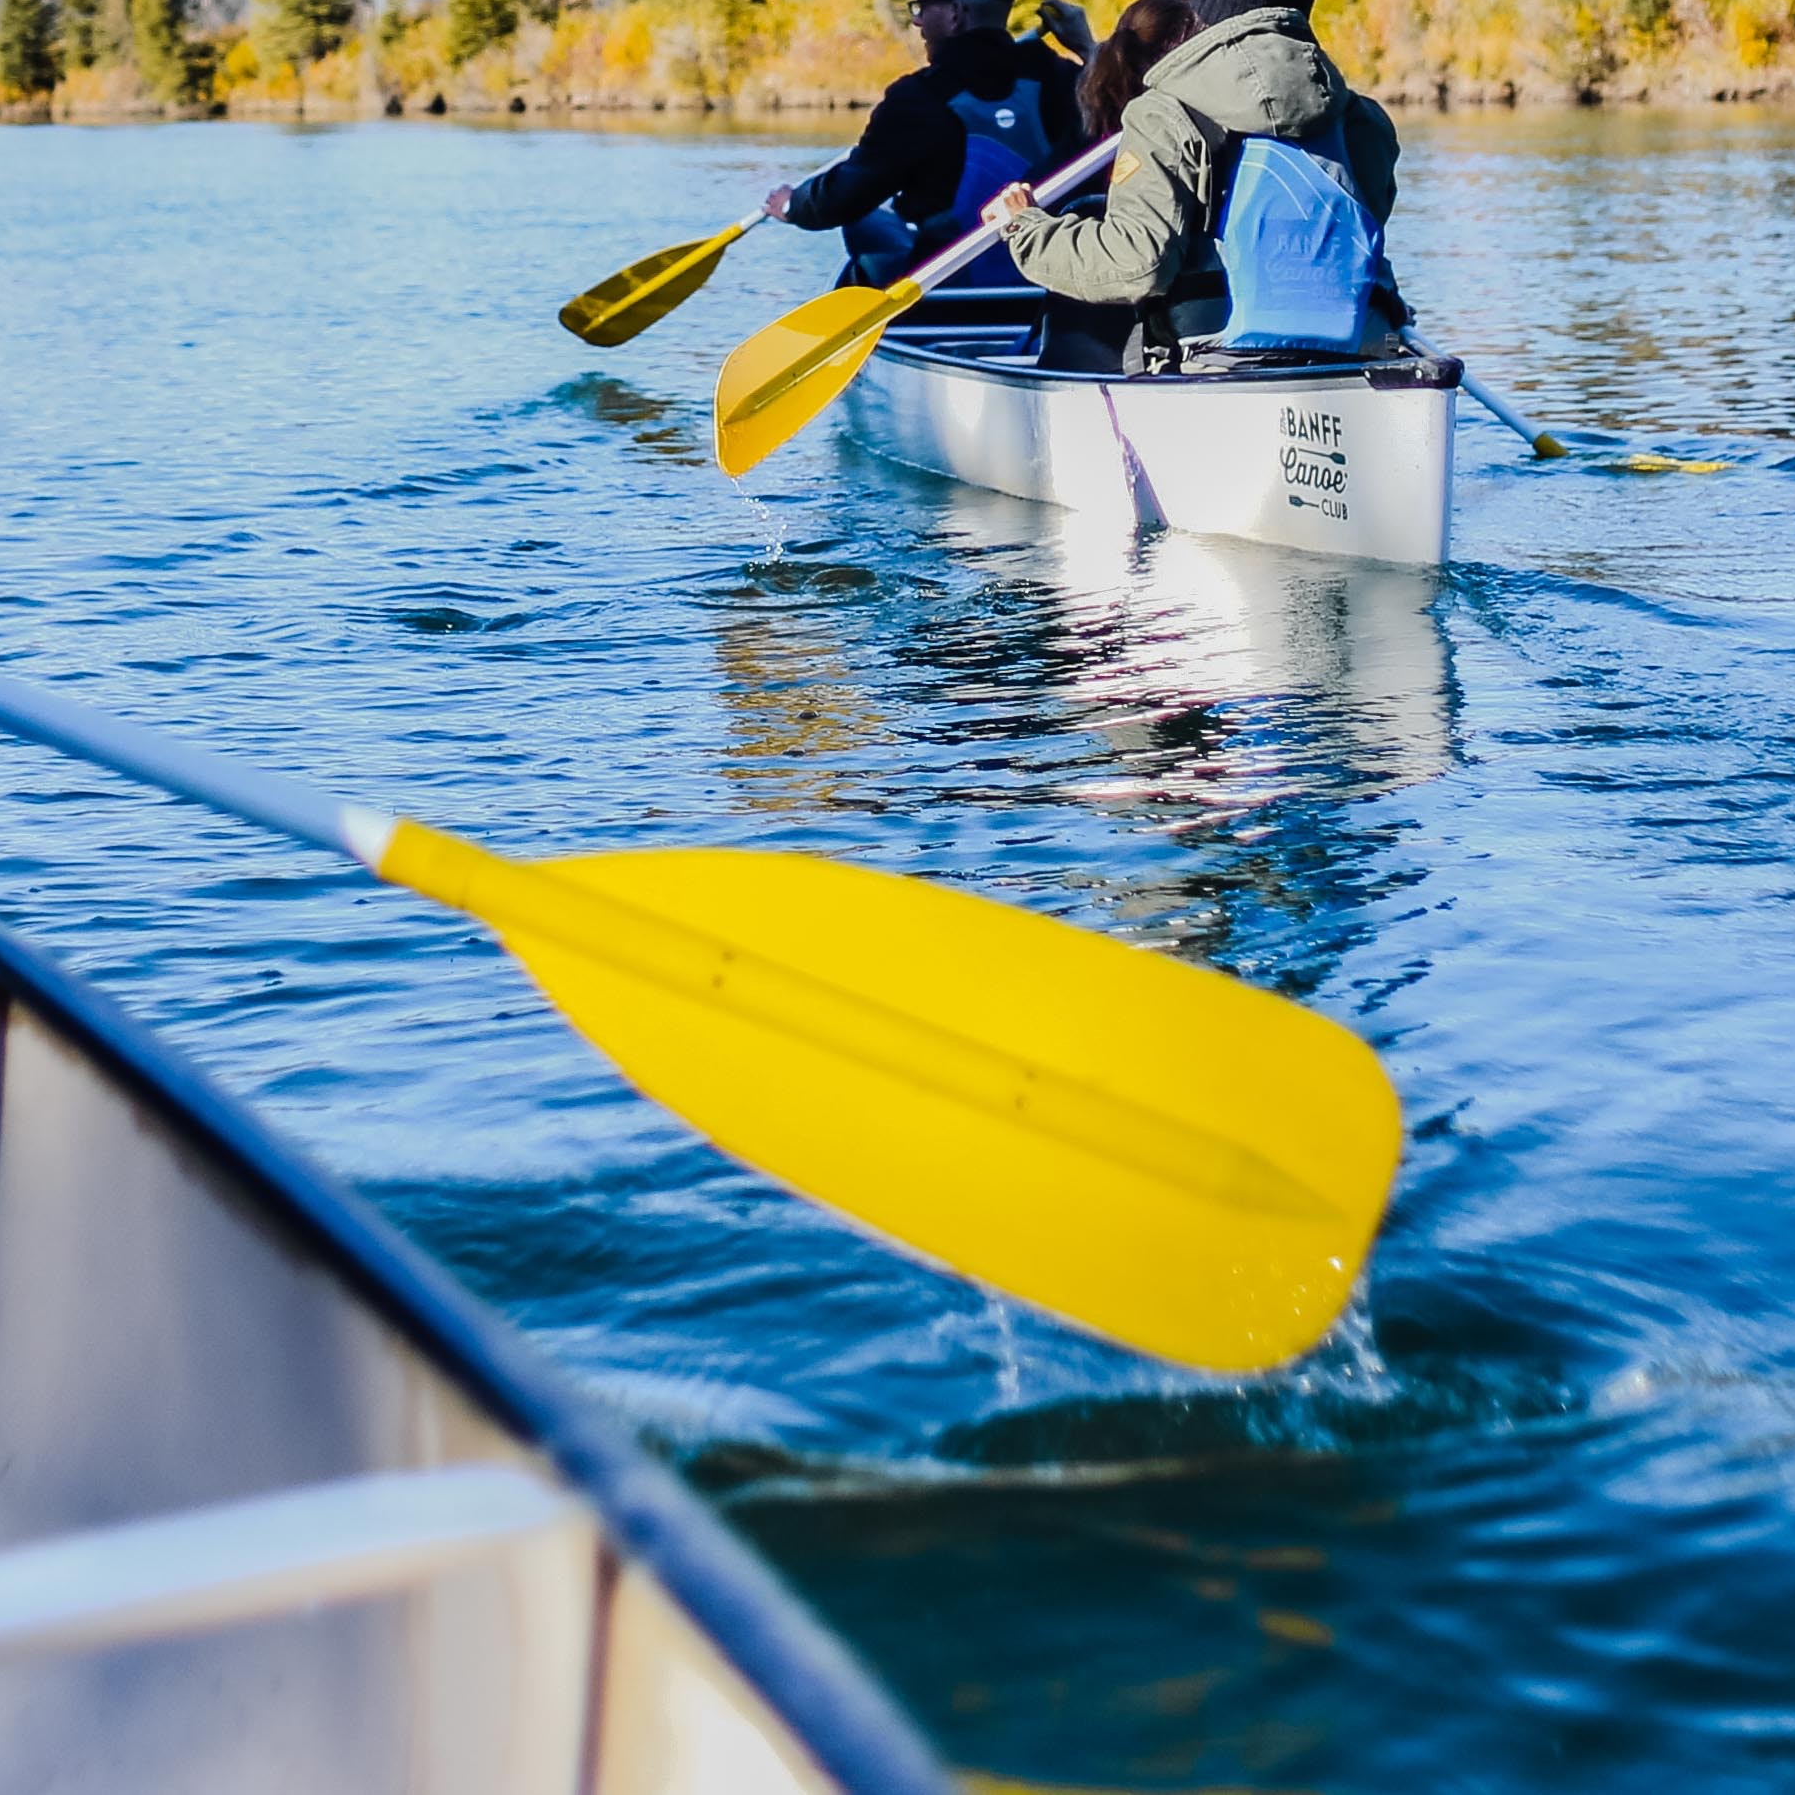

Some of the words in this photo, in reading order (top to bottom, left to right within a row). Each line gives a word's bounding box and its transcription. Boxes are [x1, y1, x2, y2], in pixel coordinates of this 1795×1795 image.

[1287, 407, 1342, 446] BANFF
[1280, 446, 1346, 494] Canoe
[1322, 499, 1348, 520] CLUB
